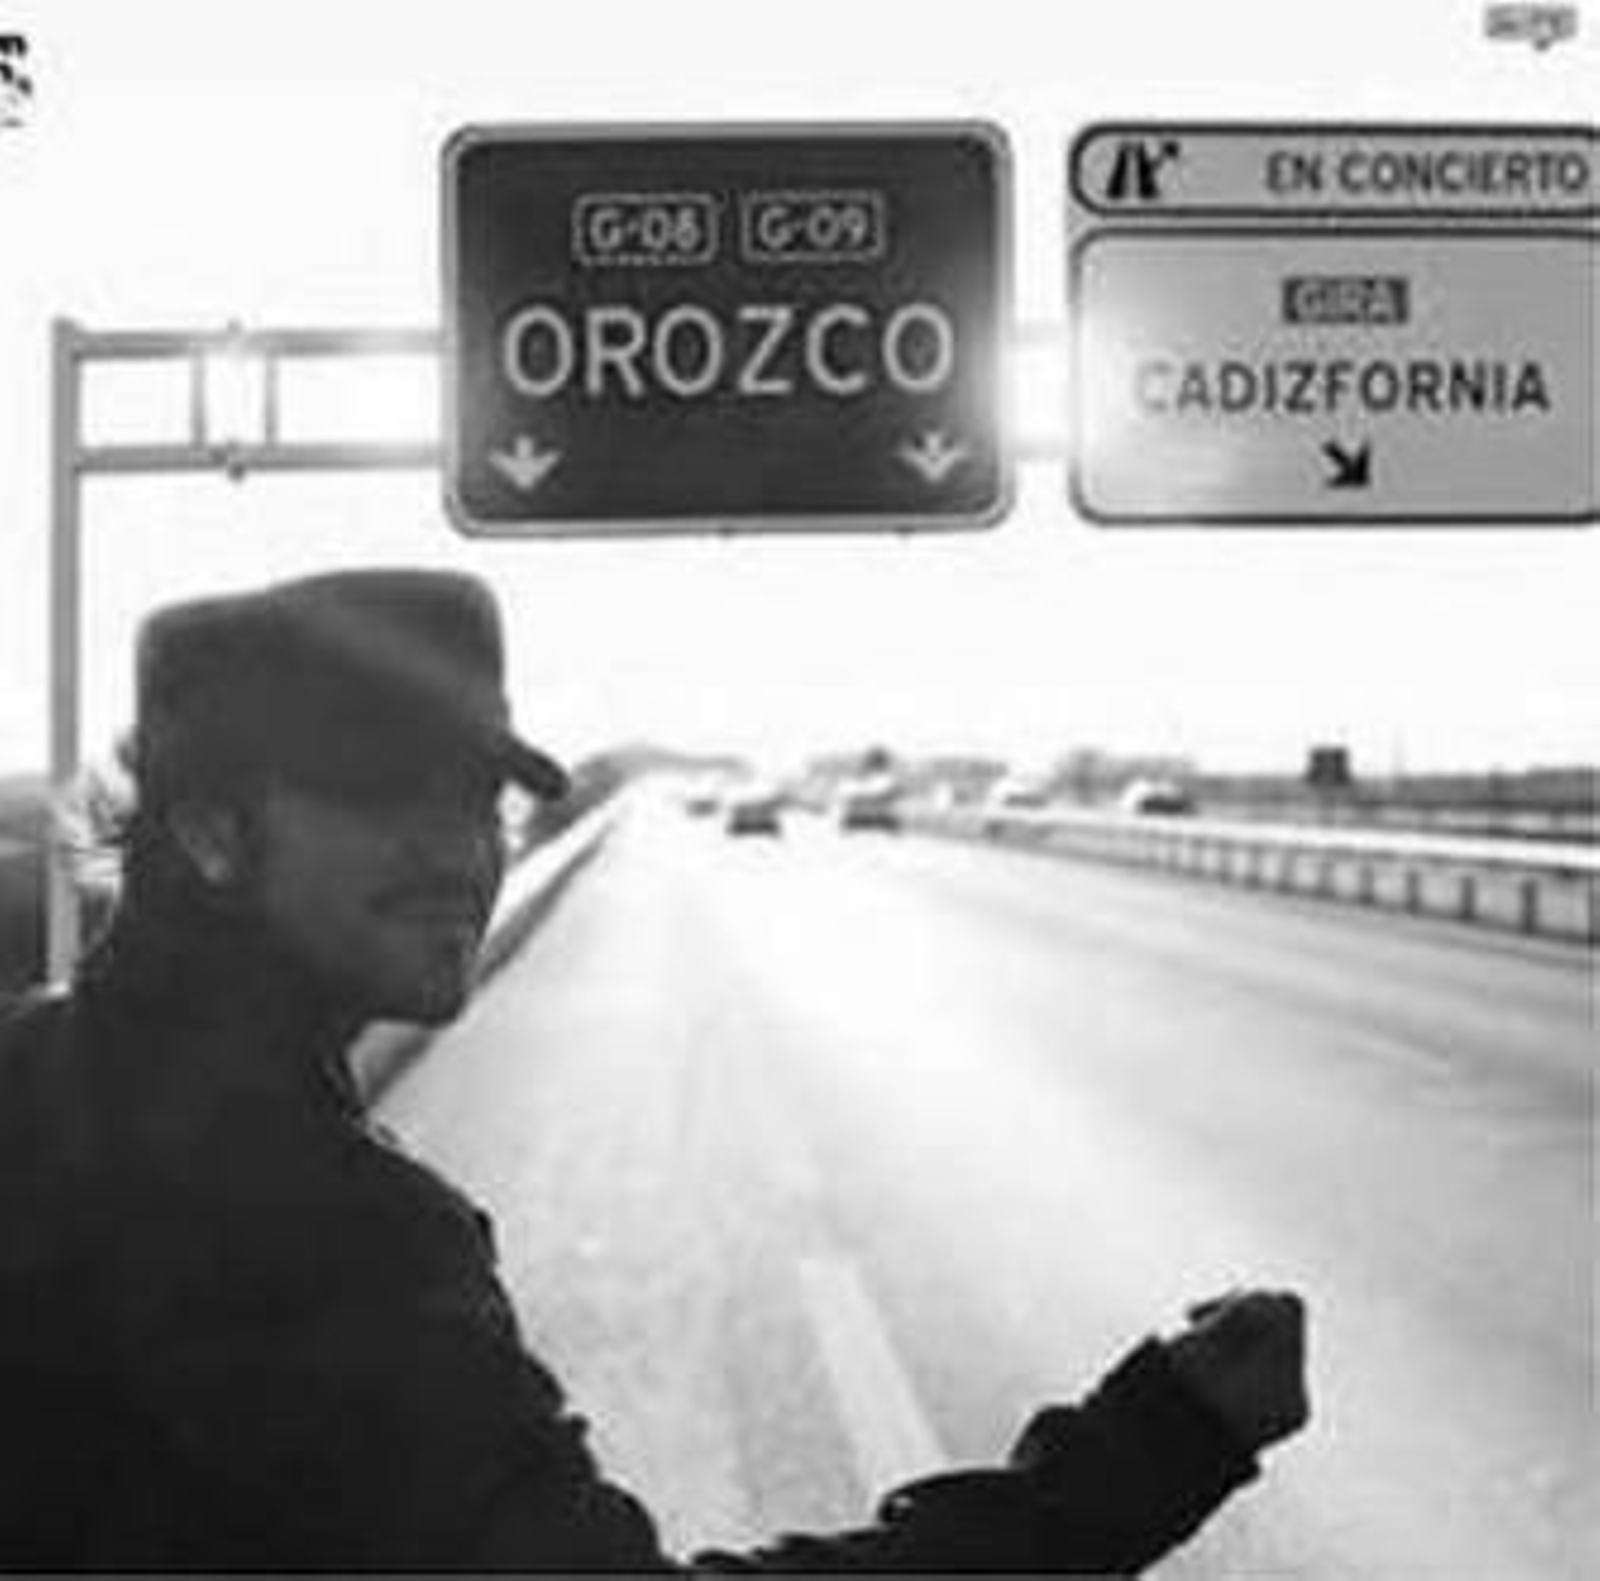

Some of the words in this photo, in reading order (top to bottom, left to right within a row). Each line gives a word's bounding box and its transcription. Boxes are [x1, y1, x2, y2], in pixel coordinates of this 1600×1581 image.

[1265, 150, 1323, 192] EN
[1338, 151, 1590, 193] CONCIERTO
[503, 303, 955, 396] OROZCO
[1136, 359, 1552, 412] CADIZFORNIA
